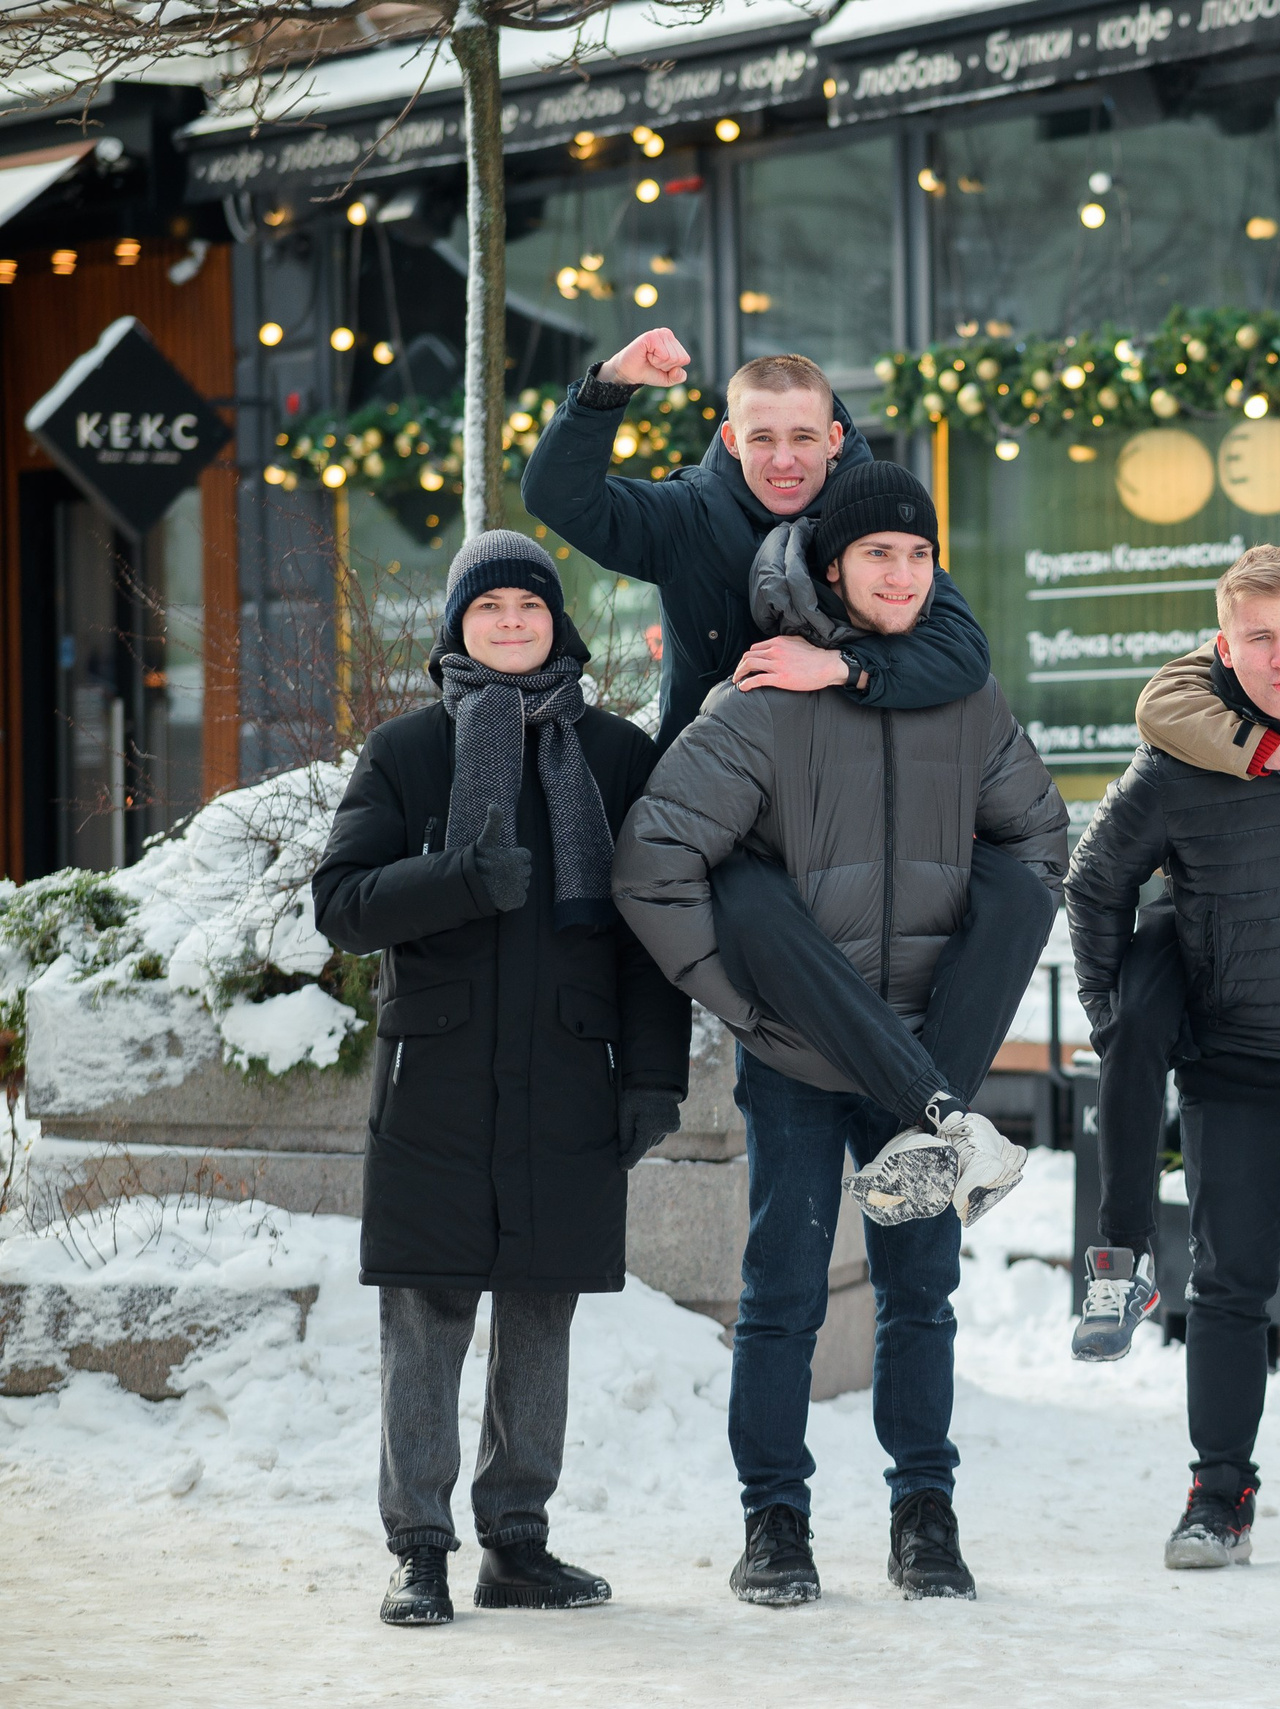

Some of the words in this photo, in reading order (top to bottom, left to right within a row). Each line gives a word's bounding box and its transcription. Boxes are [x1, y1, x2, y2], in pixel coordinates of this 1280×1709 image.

[534, 81, 625, 129] любовь
[643, 69, 722, 115] булки
[738, 45, 807, 94] кофе
[854, 48, 962, 100] любовь
[985, 28, 1073, 81] булки
[1096, 2, 1174, 55] кофе
[1098, 722, 1140, 749] мако
